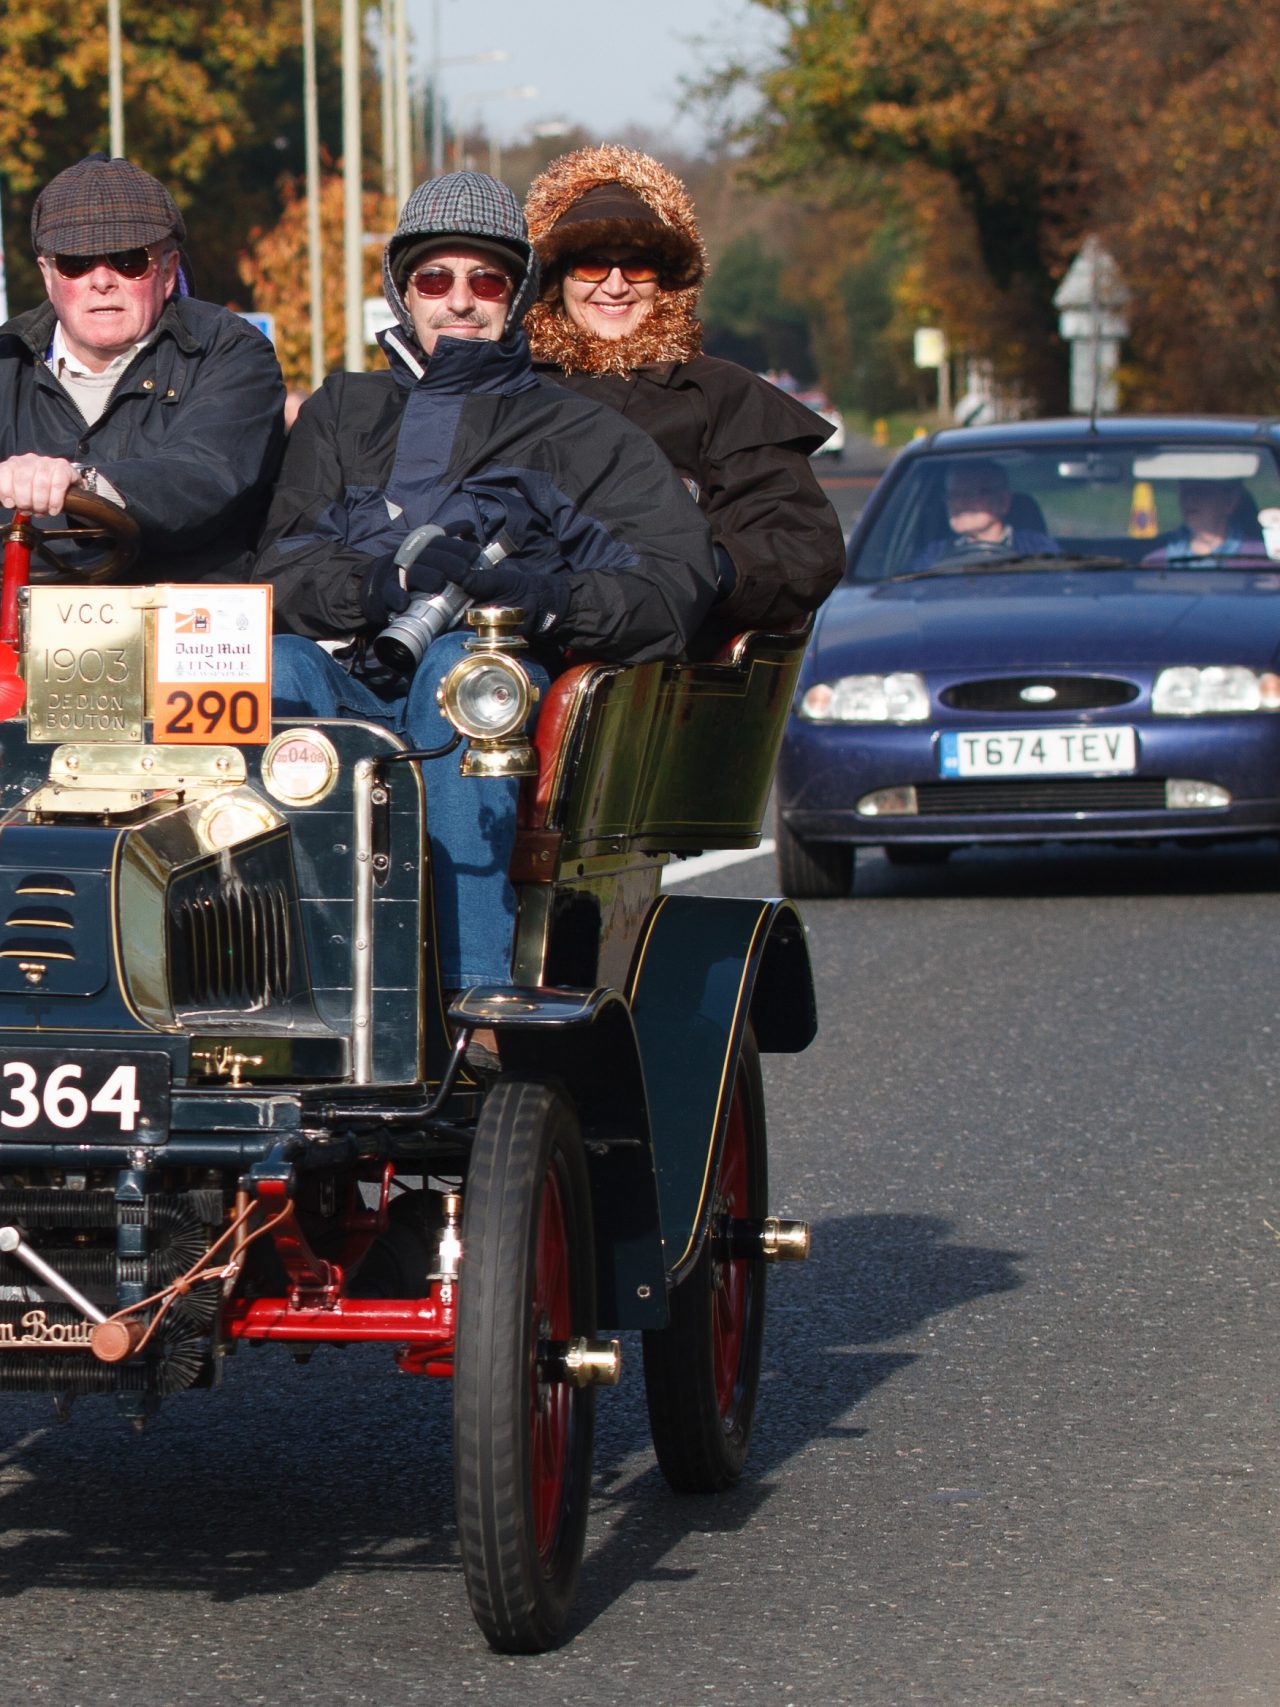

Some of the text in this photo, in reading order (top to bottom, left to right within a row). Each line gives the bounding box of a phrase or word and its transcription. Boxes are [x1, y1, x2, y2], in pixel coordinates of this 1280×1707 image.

[175, 643, 251, 658] Daily Mail
[44, 647, 130, 683] 1903
[186, 660, 251, 671] TINDLE
[45, 712, 126, 731] BOUTON
[165, 690, 260, 735] 290
[289, 747, 309, 763] 04
[963, 732, 1121, 766] T674 TEV
[21, 1309, 95, 1342] Bout
